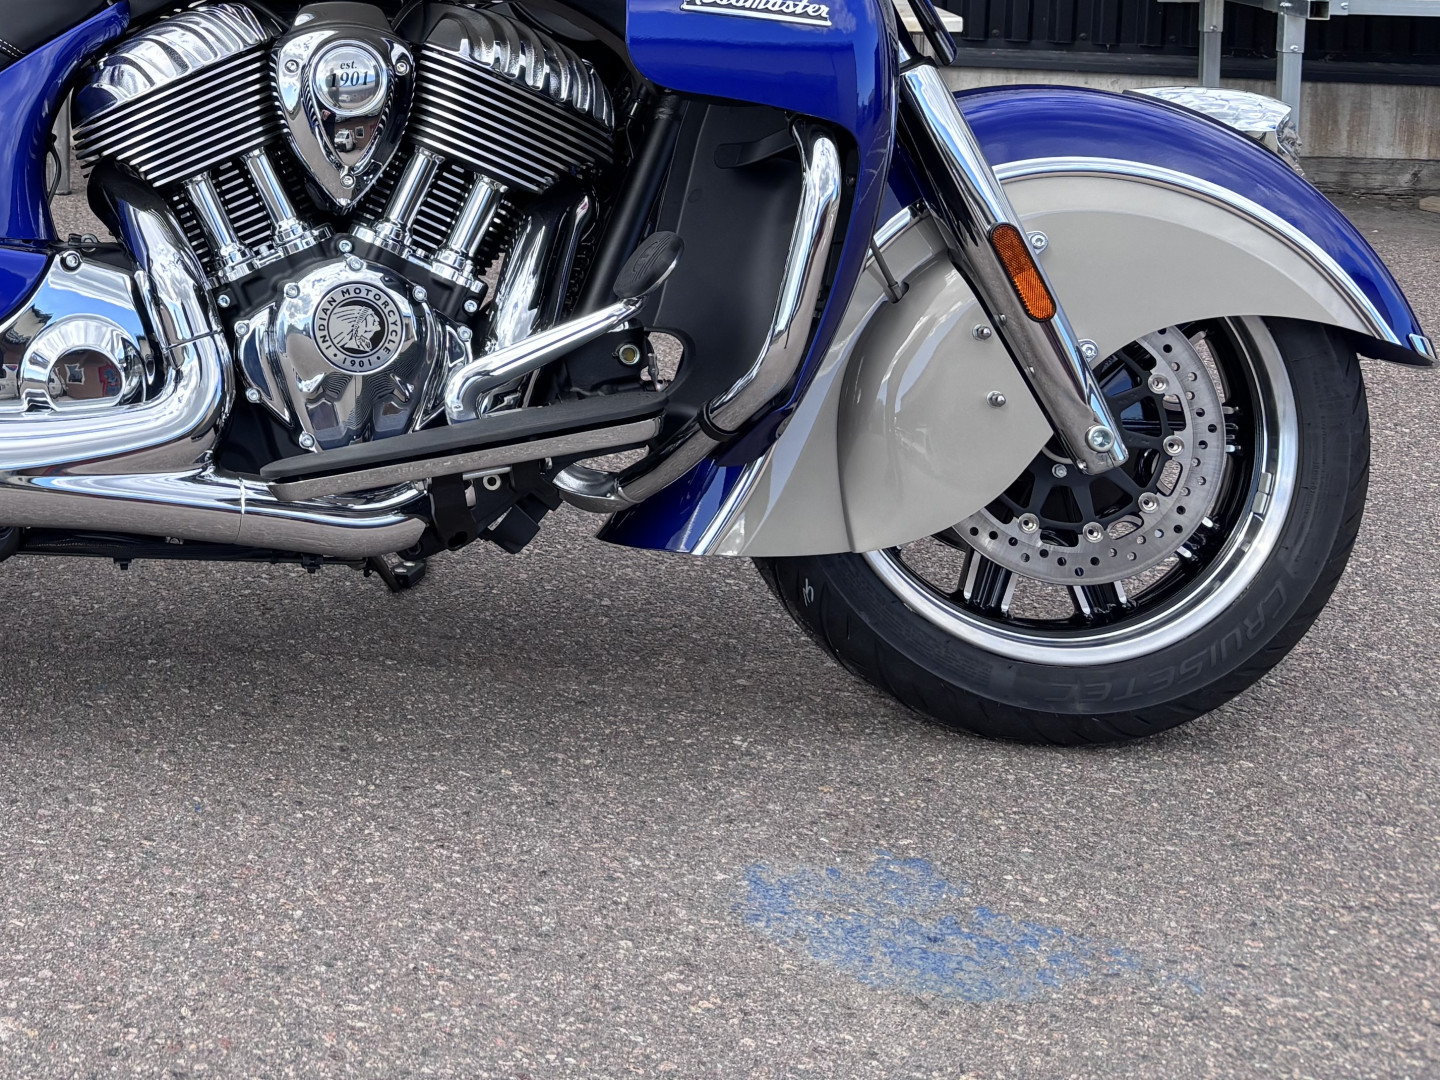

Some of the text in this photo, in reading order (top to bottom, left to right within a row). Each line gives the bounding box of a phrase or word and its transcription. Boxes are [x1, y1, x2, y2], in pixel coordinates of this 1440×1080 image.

[340, 60, 357, 70] est.
[330, 71, 368, 88] 1901
[318, 287, 399, 355] INDIAN MOTORCYCLE
[342, 356, 372, 368] 1901
